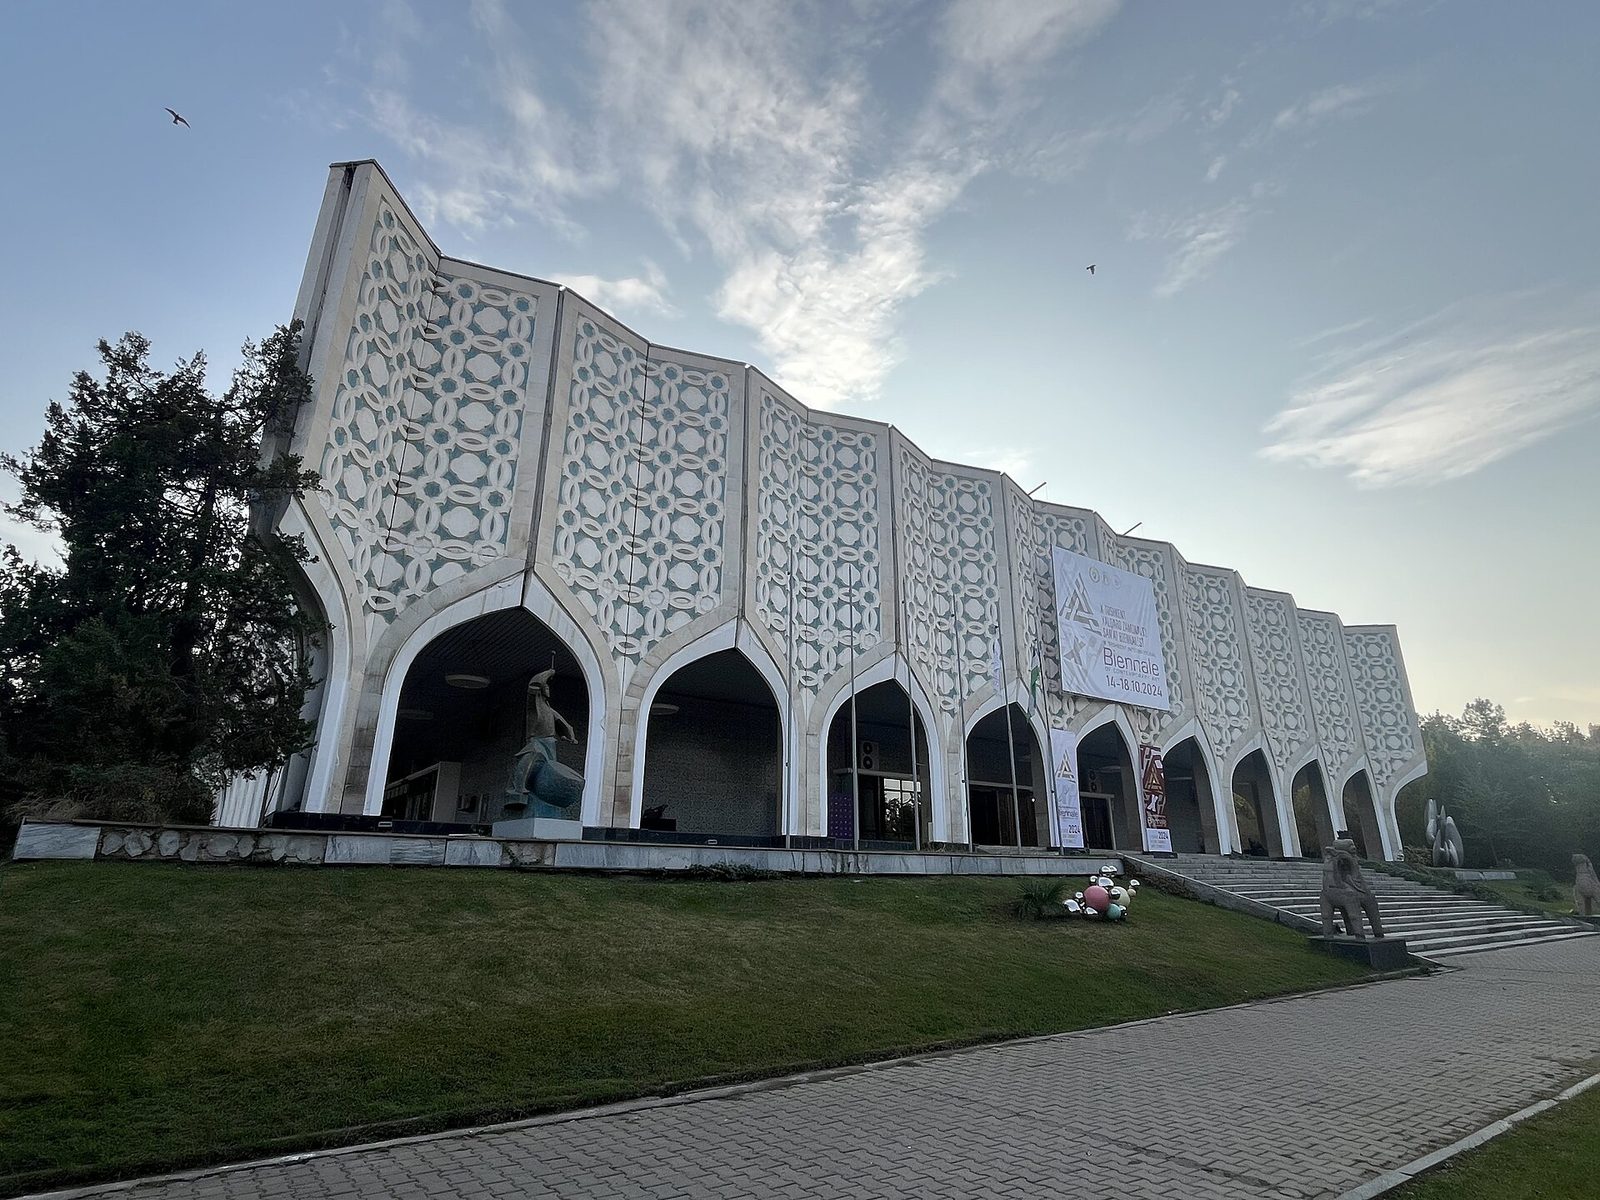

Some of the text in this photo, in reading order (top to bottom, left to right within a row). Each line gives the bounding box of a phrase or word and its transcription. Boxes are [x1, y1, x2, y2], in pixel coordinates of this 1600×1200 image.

[1103, 647, 1160, 676] Biennale
[1106, 675, 1163, 697] 14-18.10.2024
[1069, 824, 1081, 834] 2024
